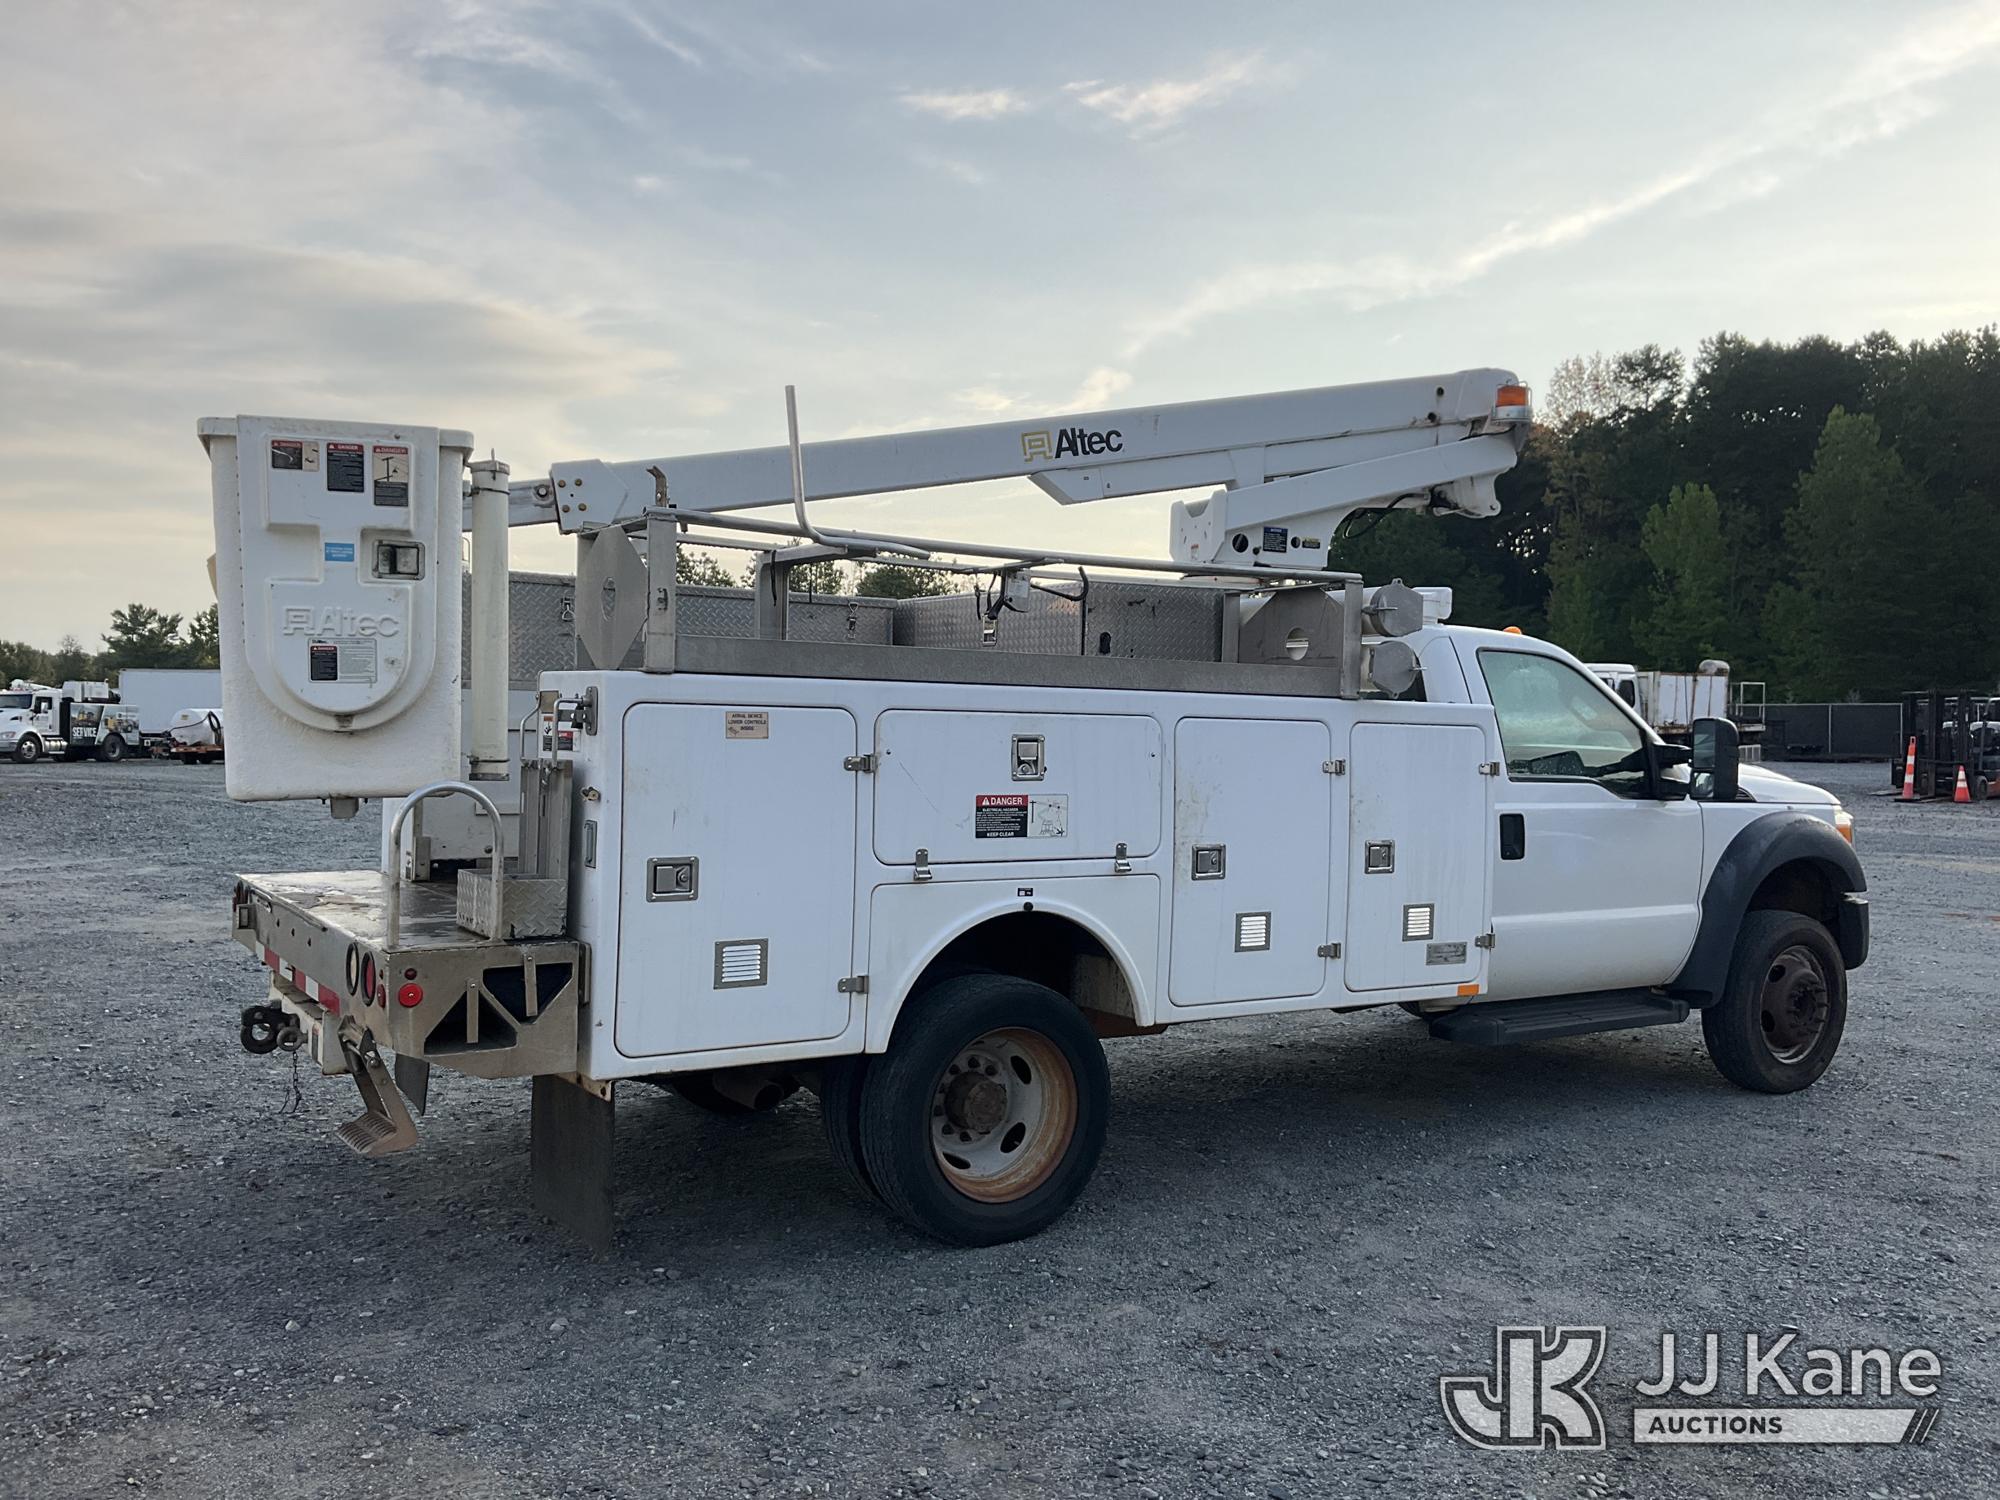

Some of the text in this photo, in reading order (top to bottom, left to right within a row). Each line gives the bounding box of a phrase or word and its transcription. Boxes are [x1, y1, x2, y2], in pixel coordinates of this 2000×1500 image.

[1055, 427, 1123, 458] Altec
[317, 607, 400, 638] Altec
[72, 726, 98, 738] SERVICE
[990, 797, 1023, 806] DANGER
